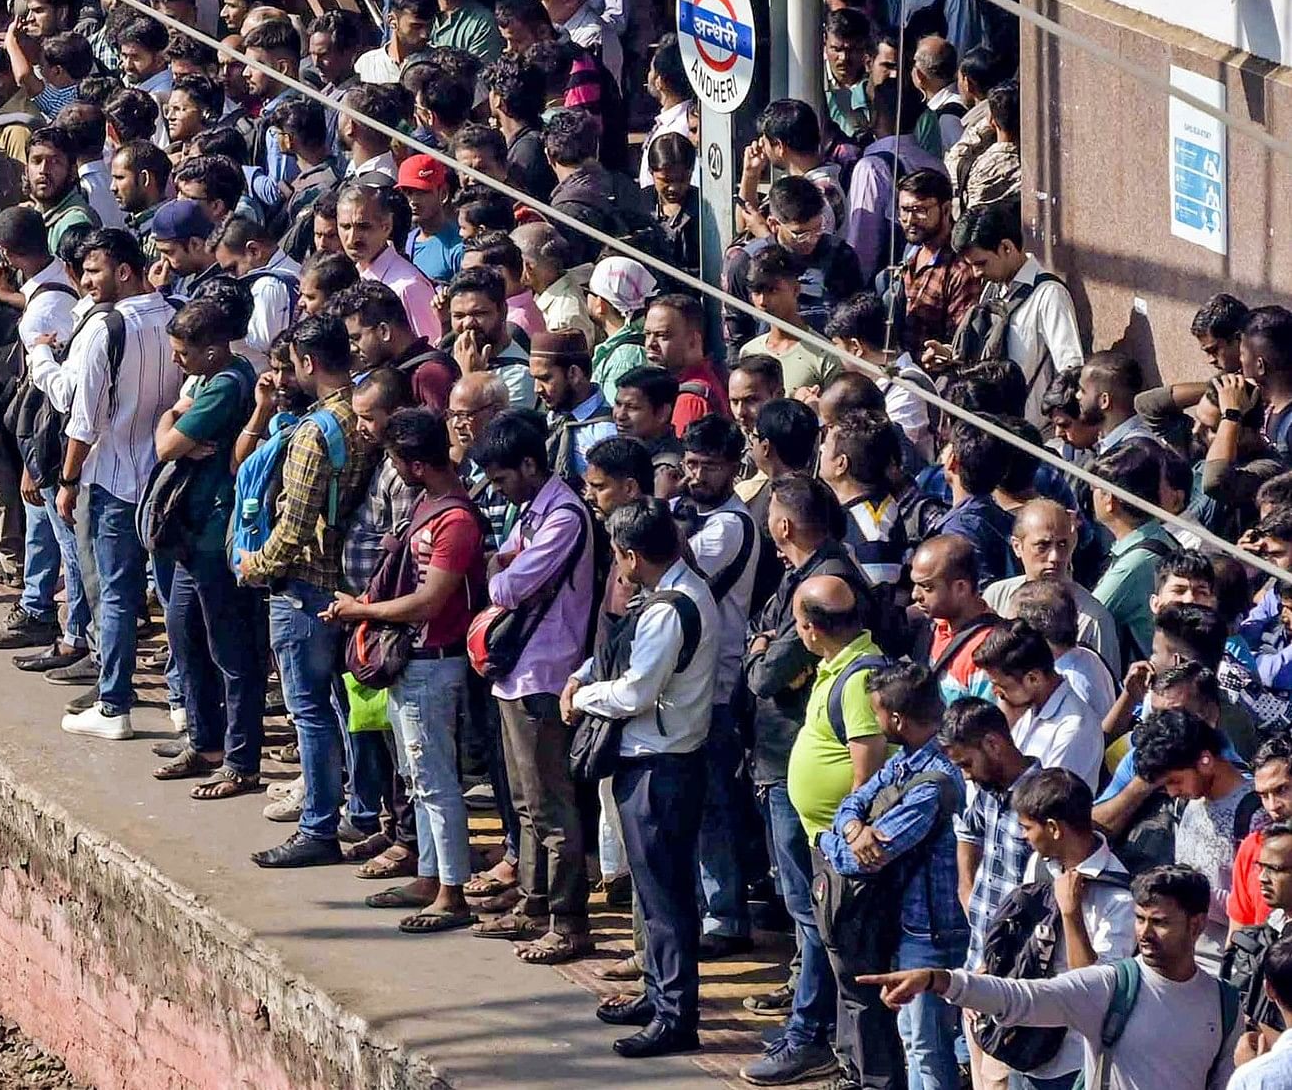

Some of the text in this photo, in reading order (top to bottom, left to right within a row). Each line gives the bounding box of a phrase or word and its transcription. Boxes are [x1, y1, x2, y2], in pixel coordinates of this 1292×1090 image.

[694, 15, 737, 50] अन्धेरी
[691, 59, 738, 103] ANDHERI
[710, 147, 721, 174] 20
